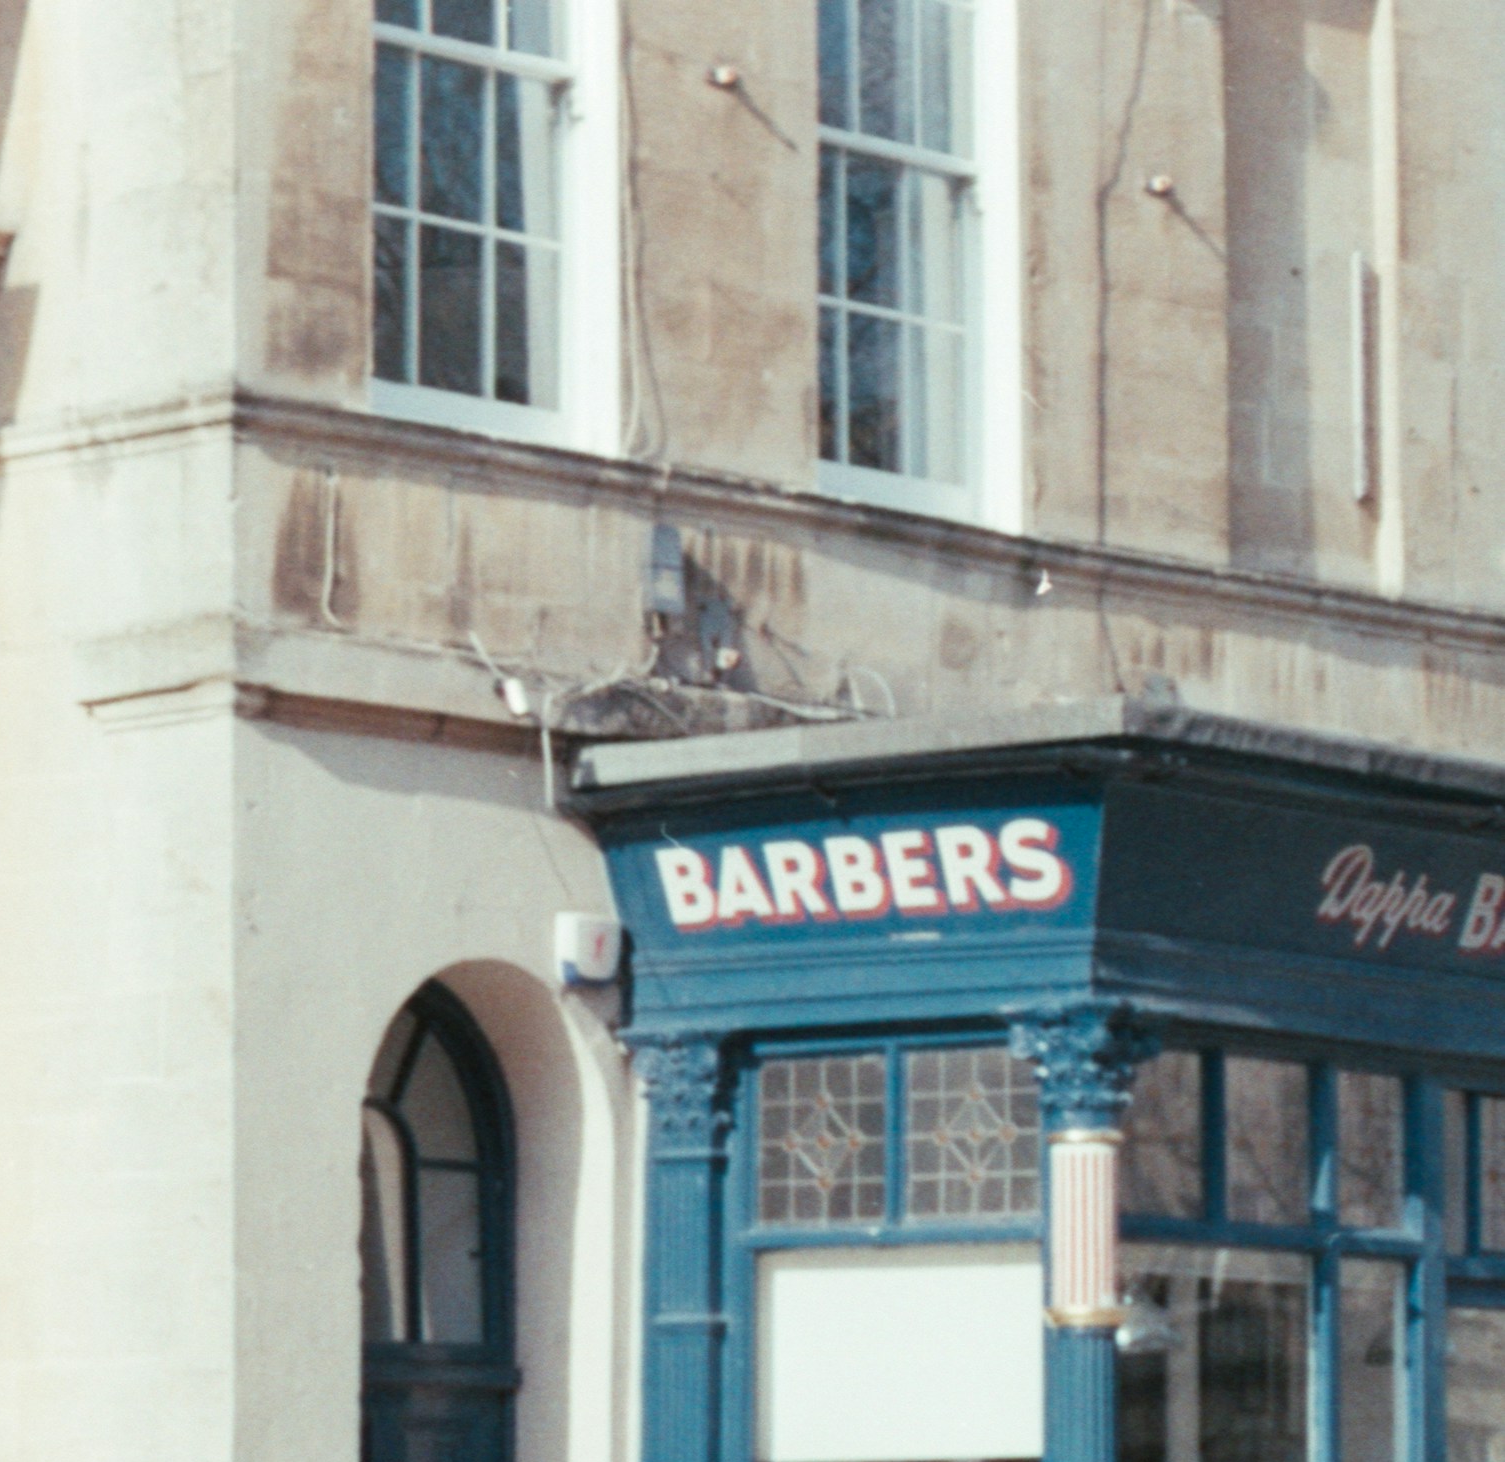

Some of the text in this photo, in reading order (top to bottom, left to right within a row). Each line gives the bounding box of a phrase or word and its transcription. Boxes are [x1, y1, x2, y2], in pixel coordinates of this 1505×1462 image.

[654, 817, 1072, 933] BARBERS
[1317, 843, 1505, 954] Dappa B
